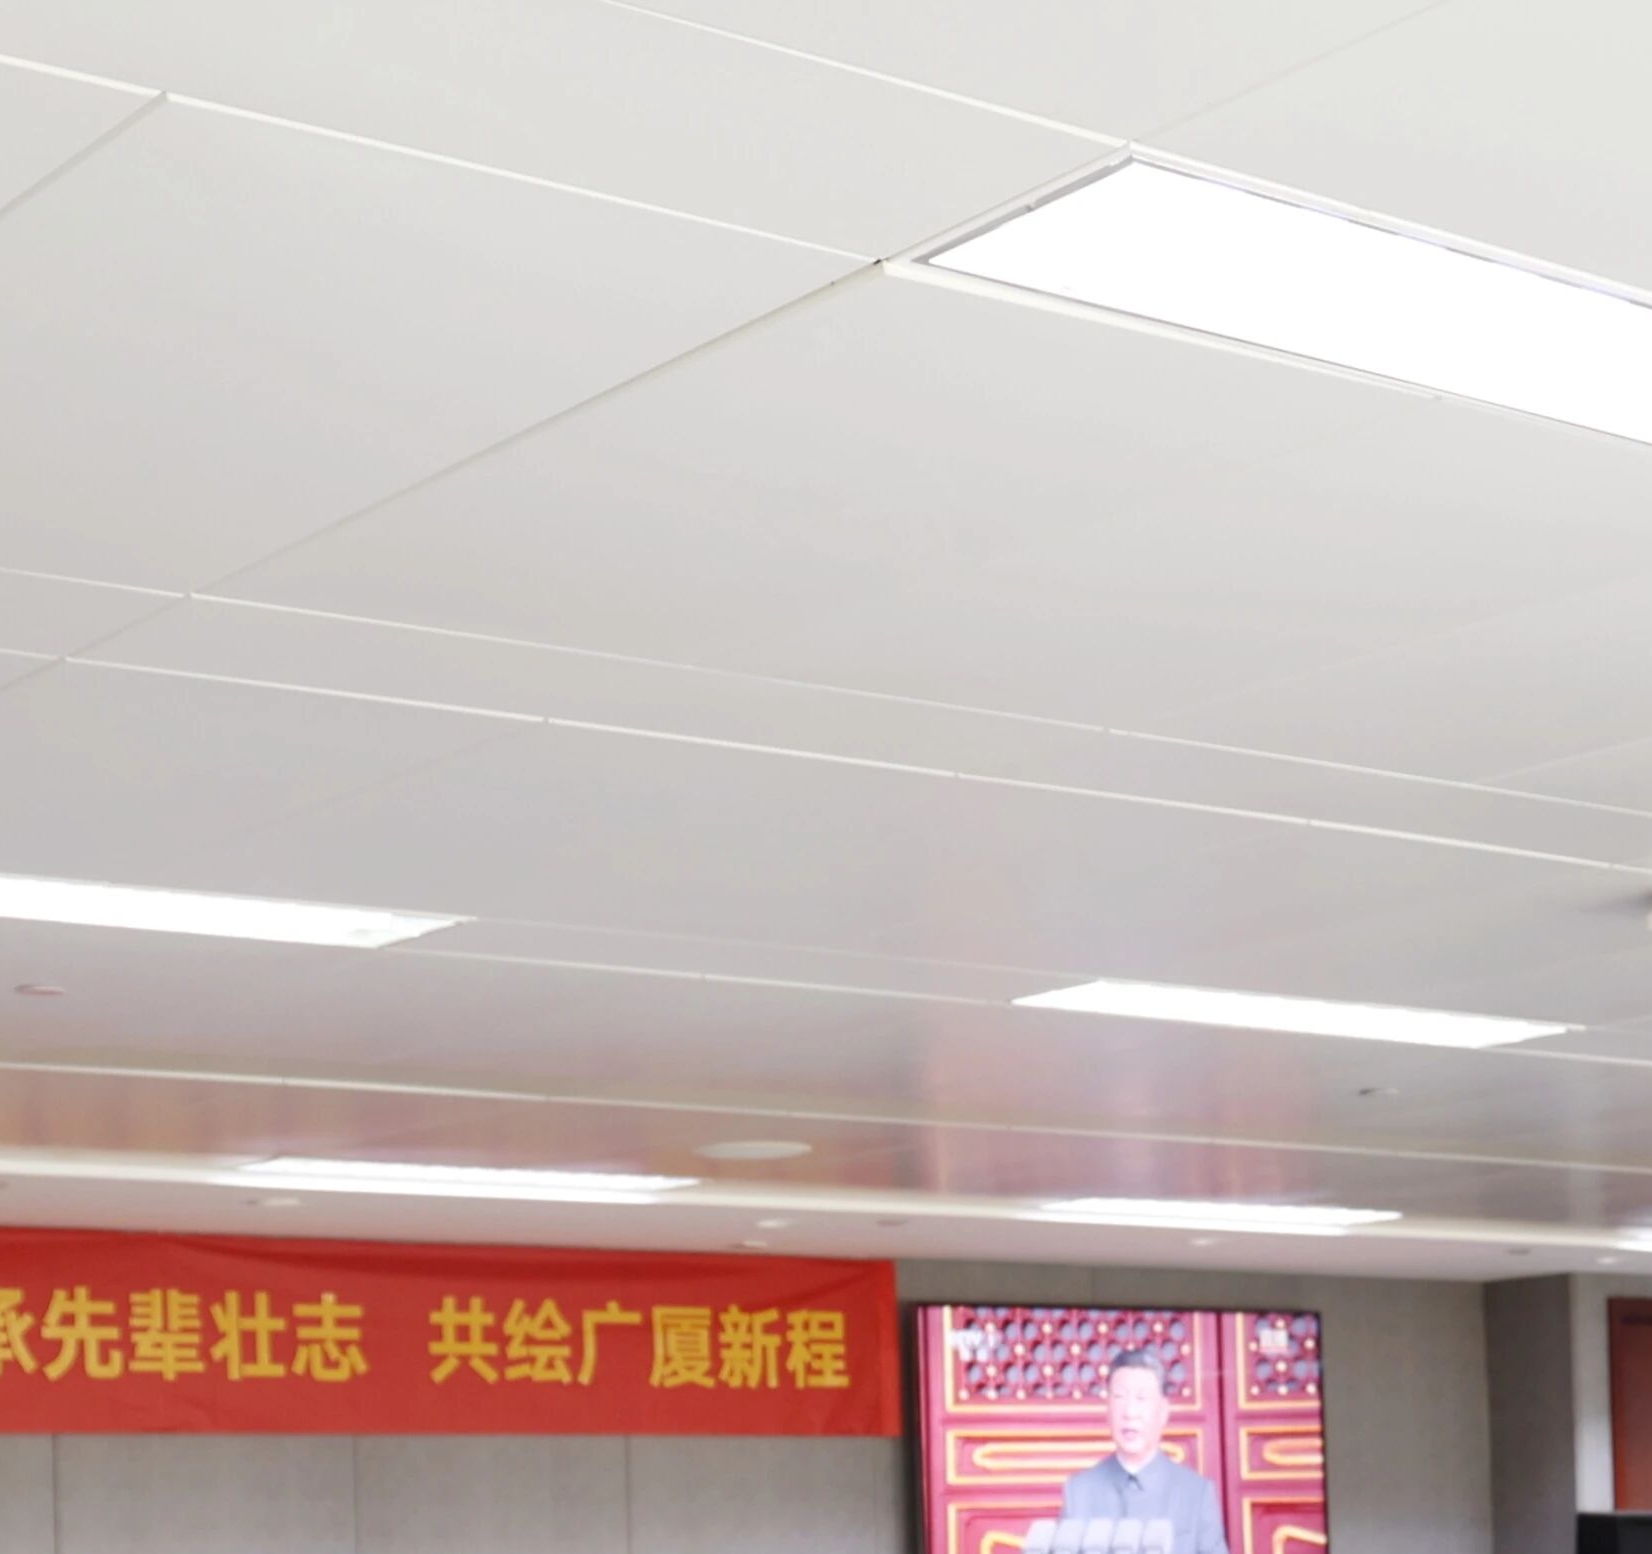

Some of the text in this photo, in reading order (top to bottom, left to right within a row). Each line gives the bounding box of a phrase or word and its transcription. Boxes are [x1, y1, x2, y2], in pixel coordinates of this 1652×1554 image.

[428, 1296, 850, 1389] 共绘广厦新程
